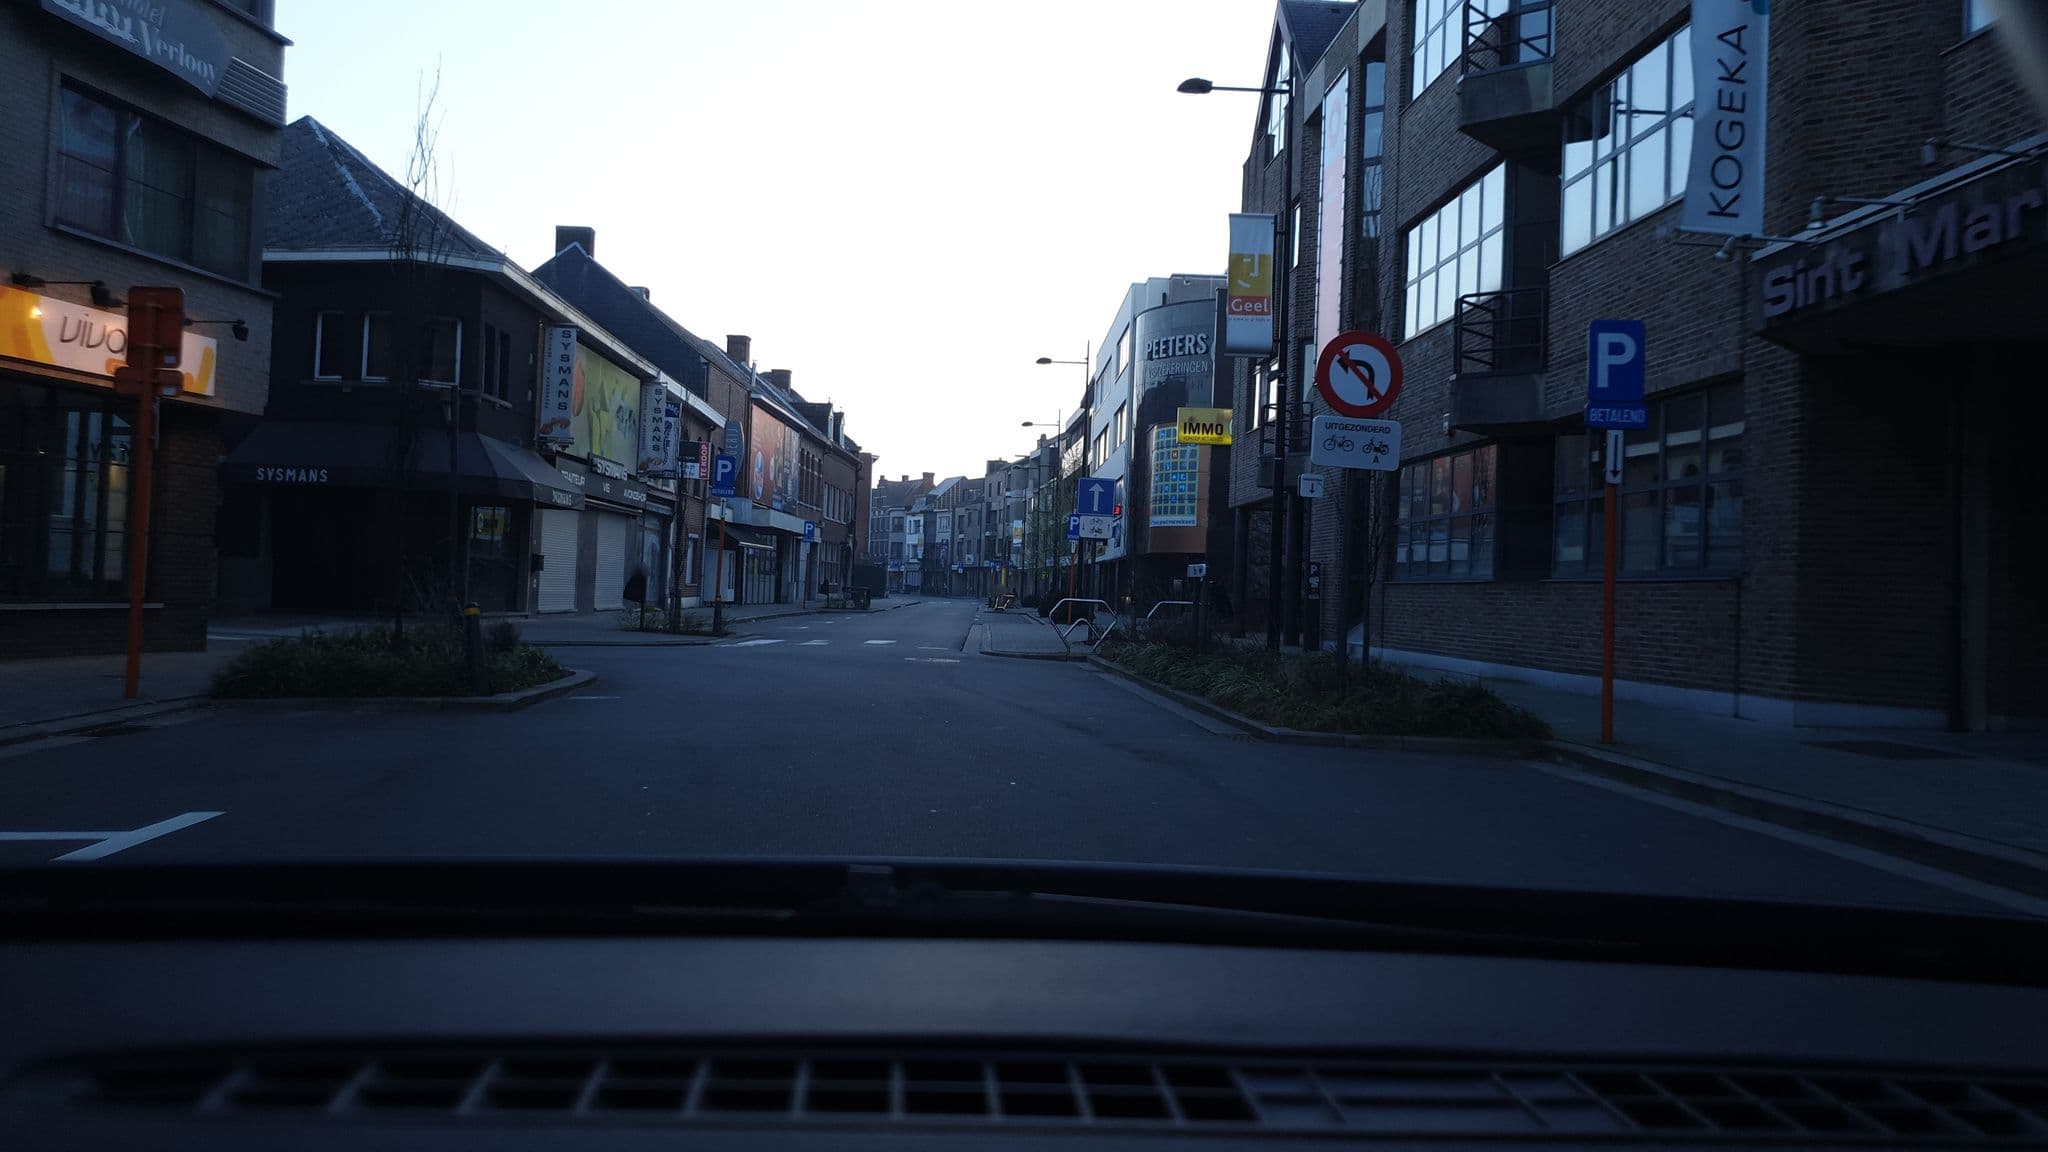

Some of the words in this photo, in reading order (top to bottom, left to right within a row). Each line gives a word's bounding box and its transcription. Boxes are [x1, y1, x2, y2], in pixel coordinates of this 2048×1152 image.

[1707, 25, 1748, 218] KOGEKA
[1763, 246, 1867, 319] Sint
[1893, 188, 2048, 277] Mar
[1231, 298, 1269, 313] Geel
[1146, 333, 1209, 360] PEETERS
[557, 330, 571, 411] SYSMANS
[1596, 332, 1637, 388] P
[651, 388, 663, 452] SYSMANS
[1589, 408, 1647, 423] BETALEND
[1183, 422, 1224, 436] IMMO
[1325, 422, 1391, 434] UITGEZONDERD
[257, 467, 329, 483] SYSMANS
[716, 459, 733, 481] P
